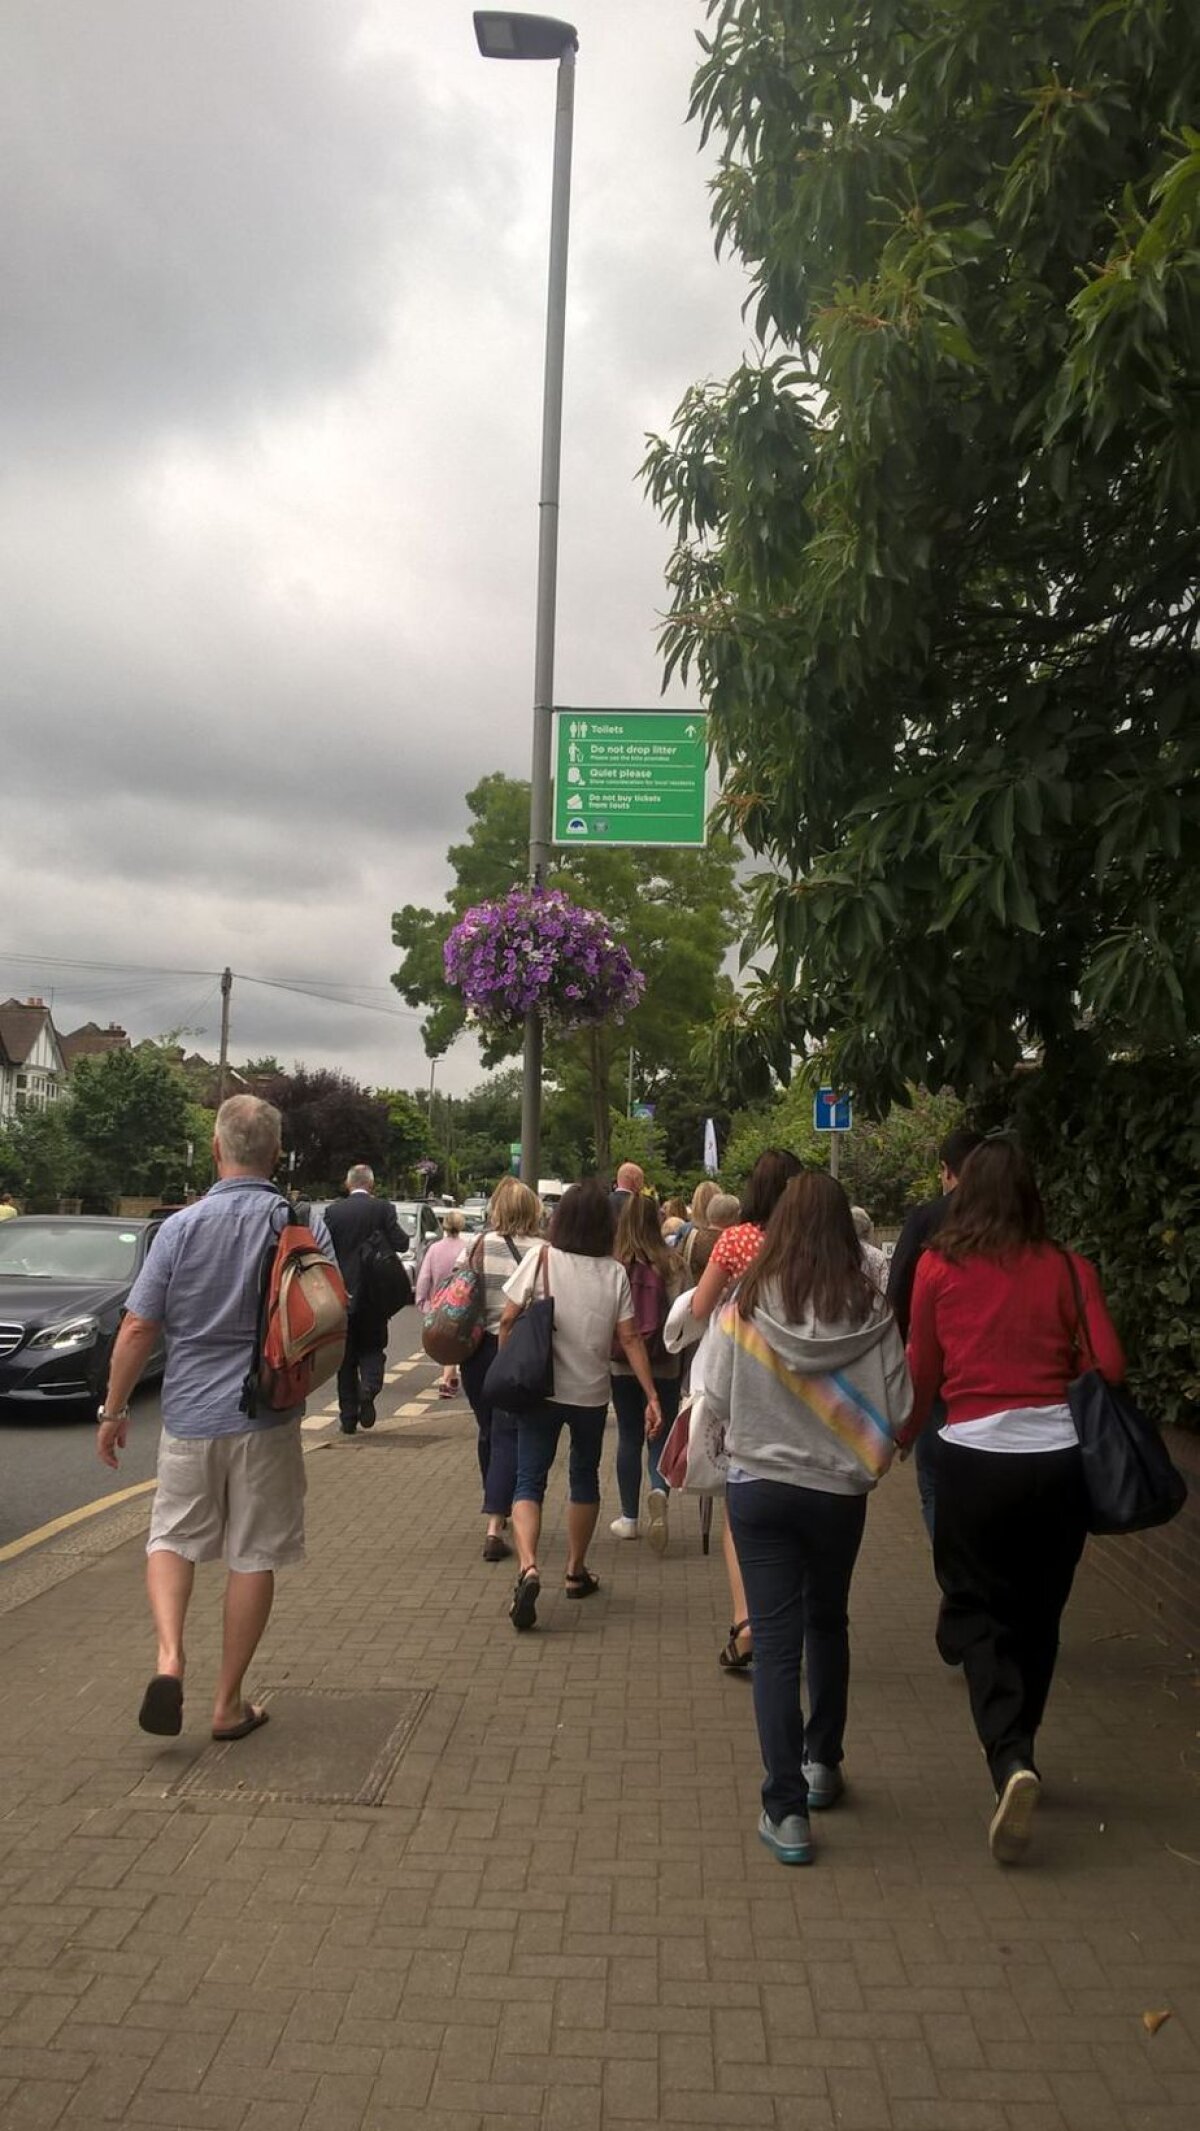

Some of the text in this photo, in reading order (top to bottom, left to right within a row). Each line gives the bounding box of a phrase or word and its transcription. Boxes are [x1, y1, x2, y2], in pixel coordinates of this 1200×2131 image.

[591, 725, 624, 734] Toilets
[590, 745, 677, 756] Do not drop litter
[590, 769, 652, 779] Quiet please
[589, 793, 600, 802] Do
[602, 794, 616, 802] not
[617, 794, 632, 803] buy
[609, 802, 630, 810] touts
